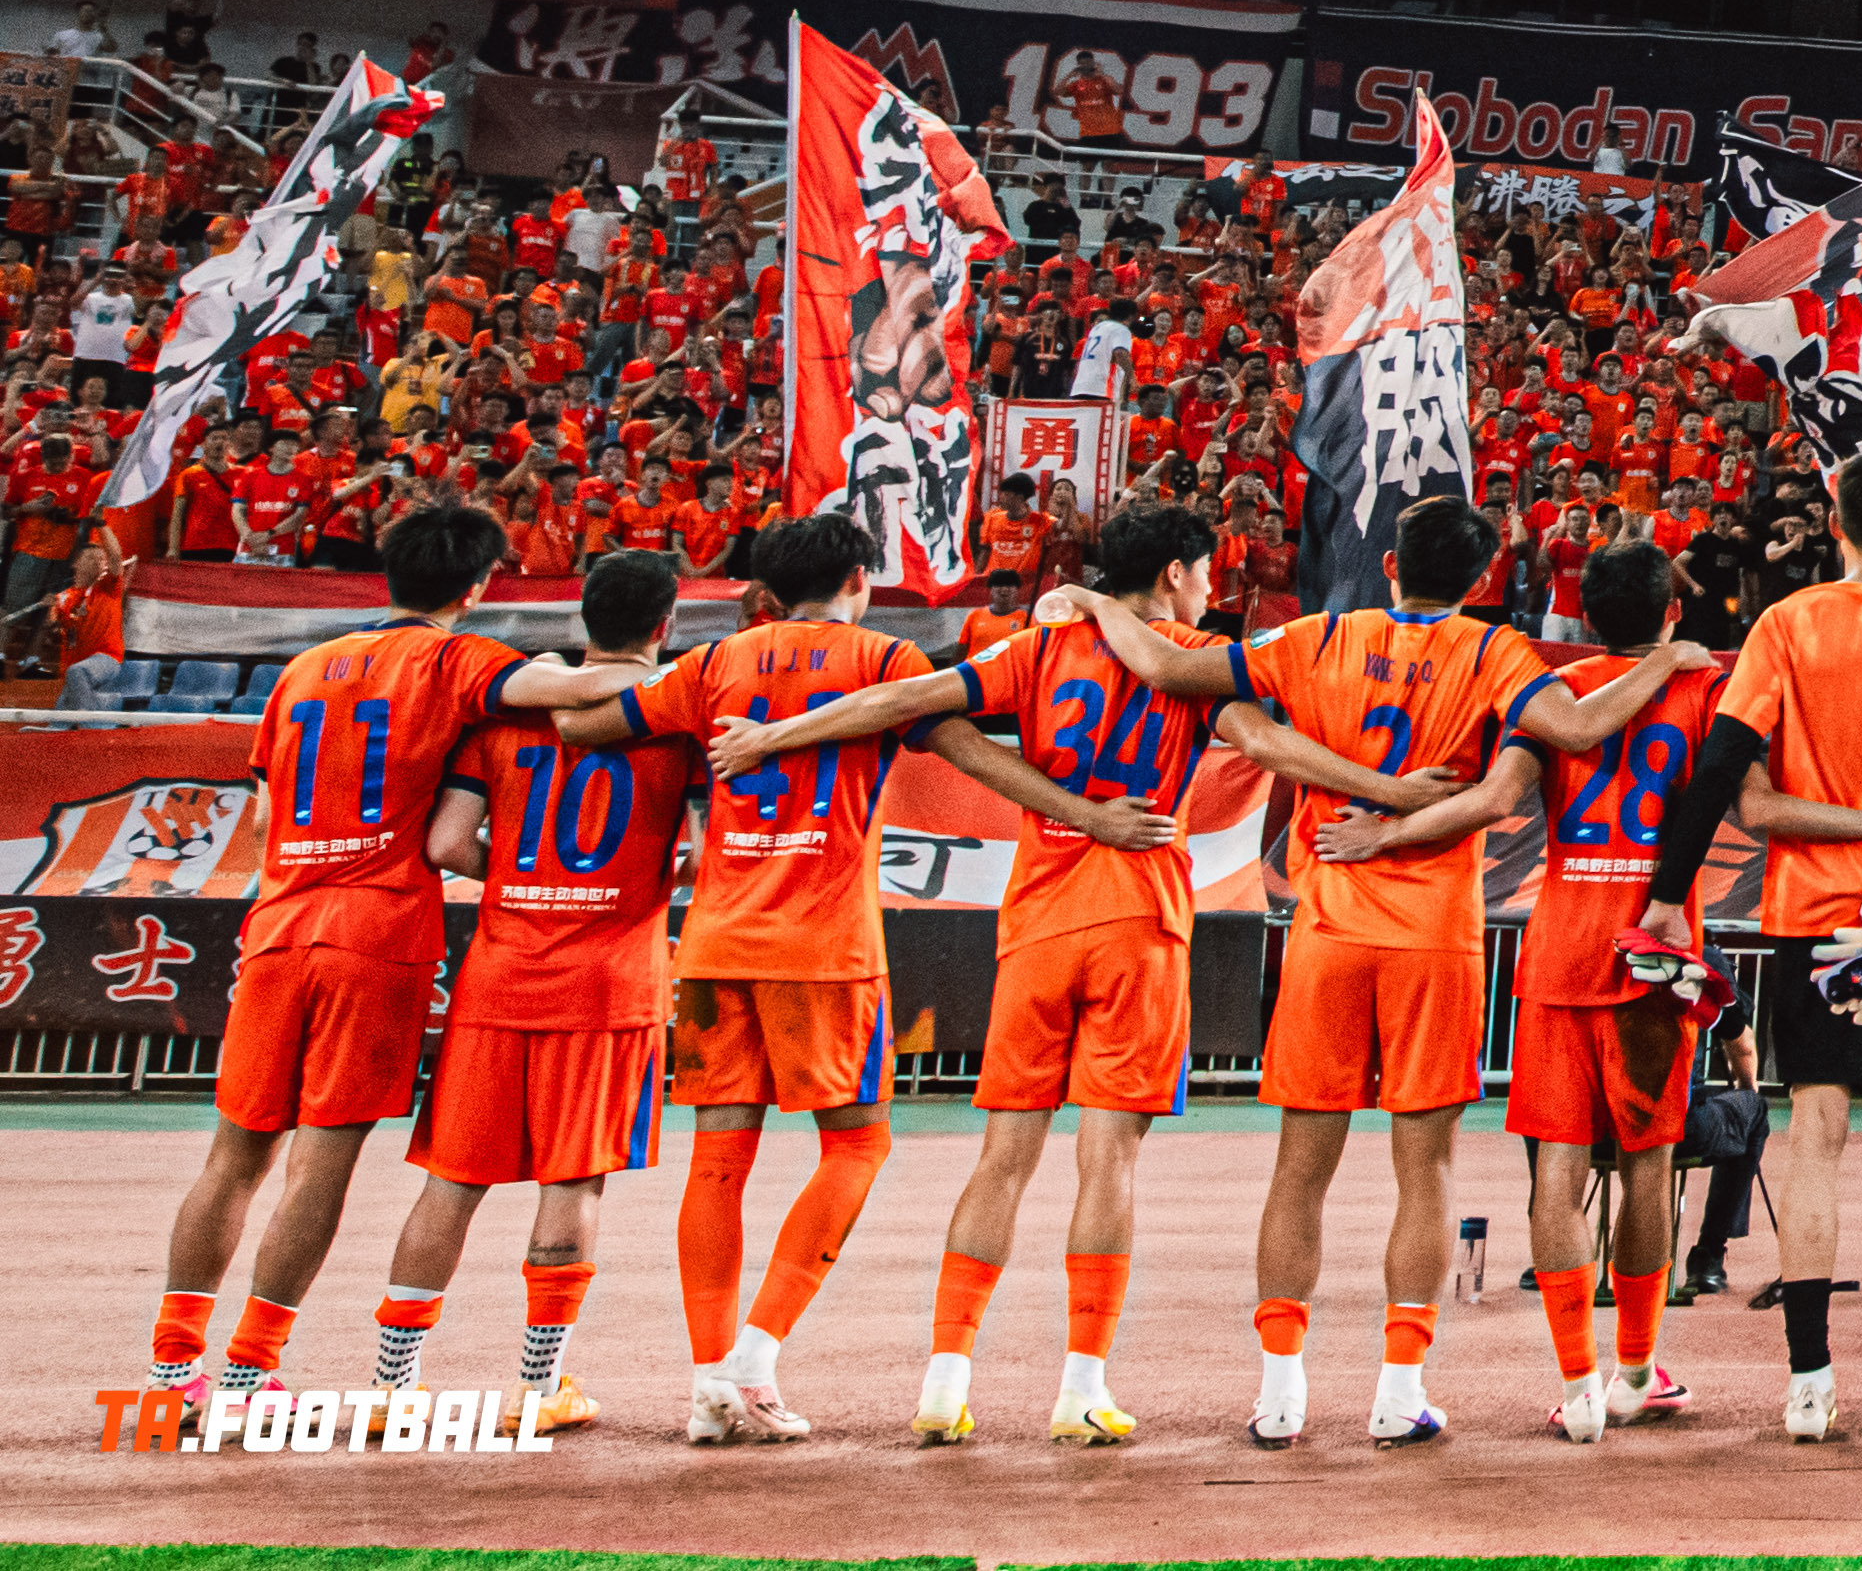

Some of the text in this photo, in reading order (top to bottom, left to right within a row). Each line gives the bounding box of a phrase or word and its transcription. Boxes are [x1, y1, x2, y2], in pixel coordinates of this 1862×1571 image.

[290, 699, 389, 826] 11
[1051, 677, 1164, 805] 34
[1360, 705, 1412, 819] 2
[1557, 723, 1689, 848] 28
[514, 745, 633, 874] 10
